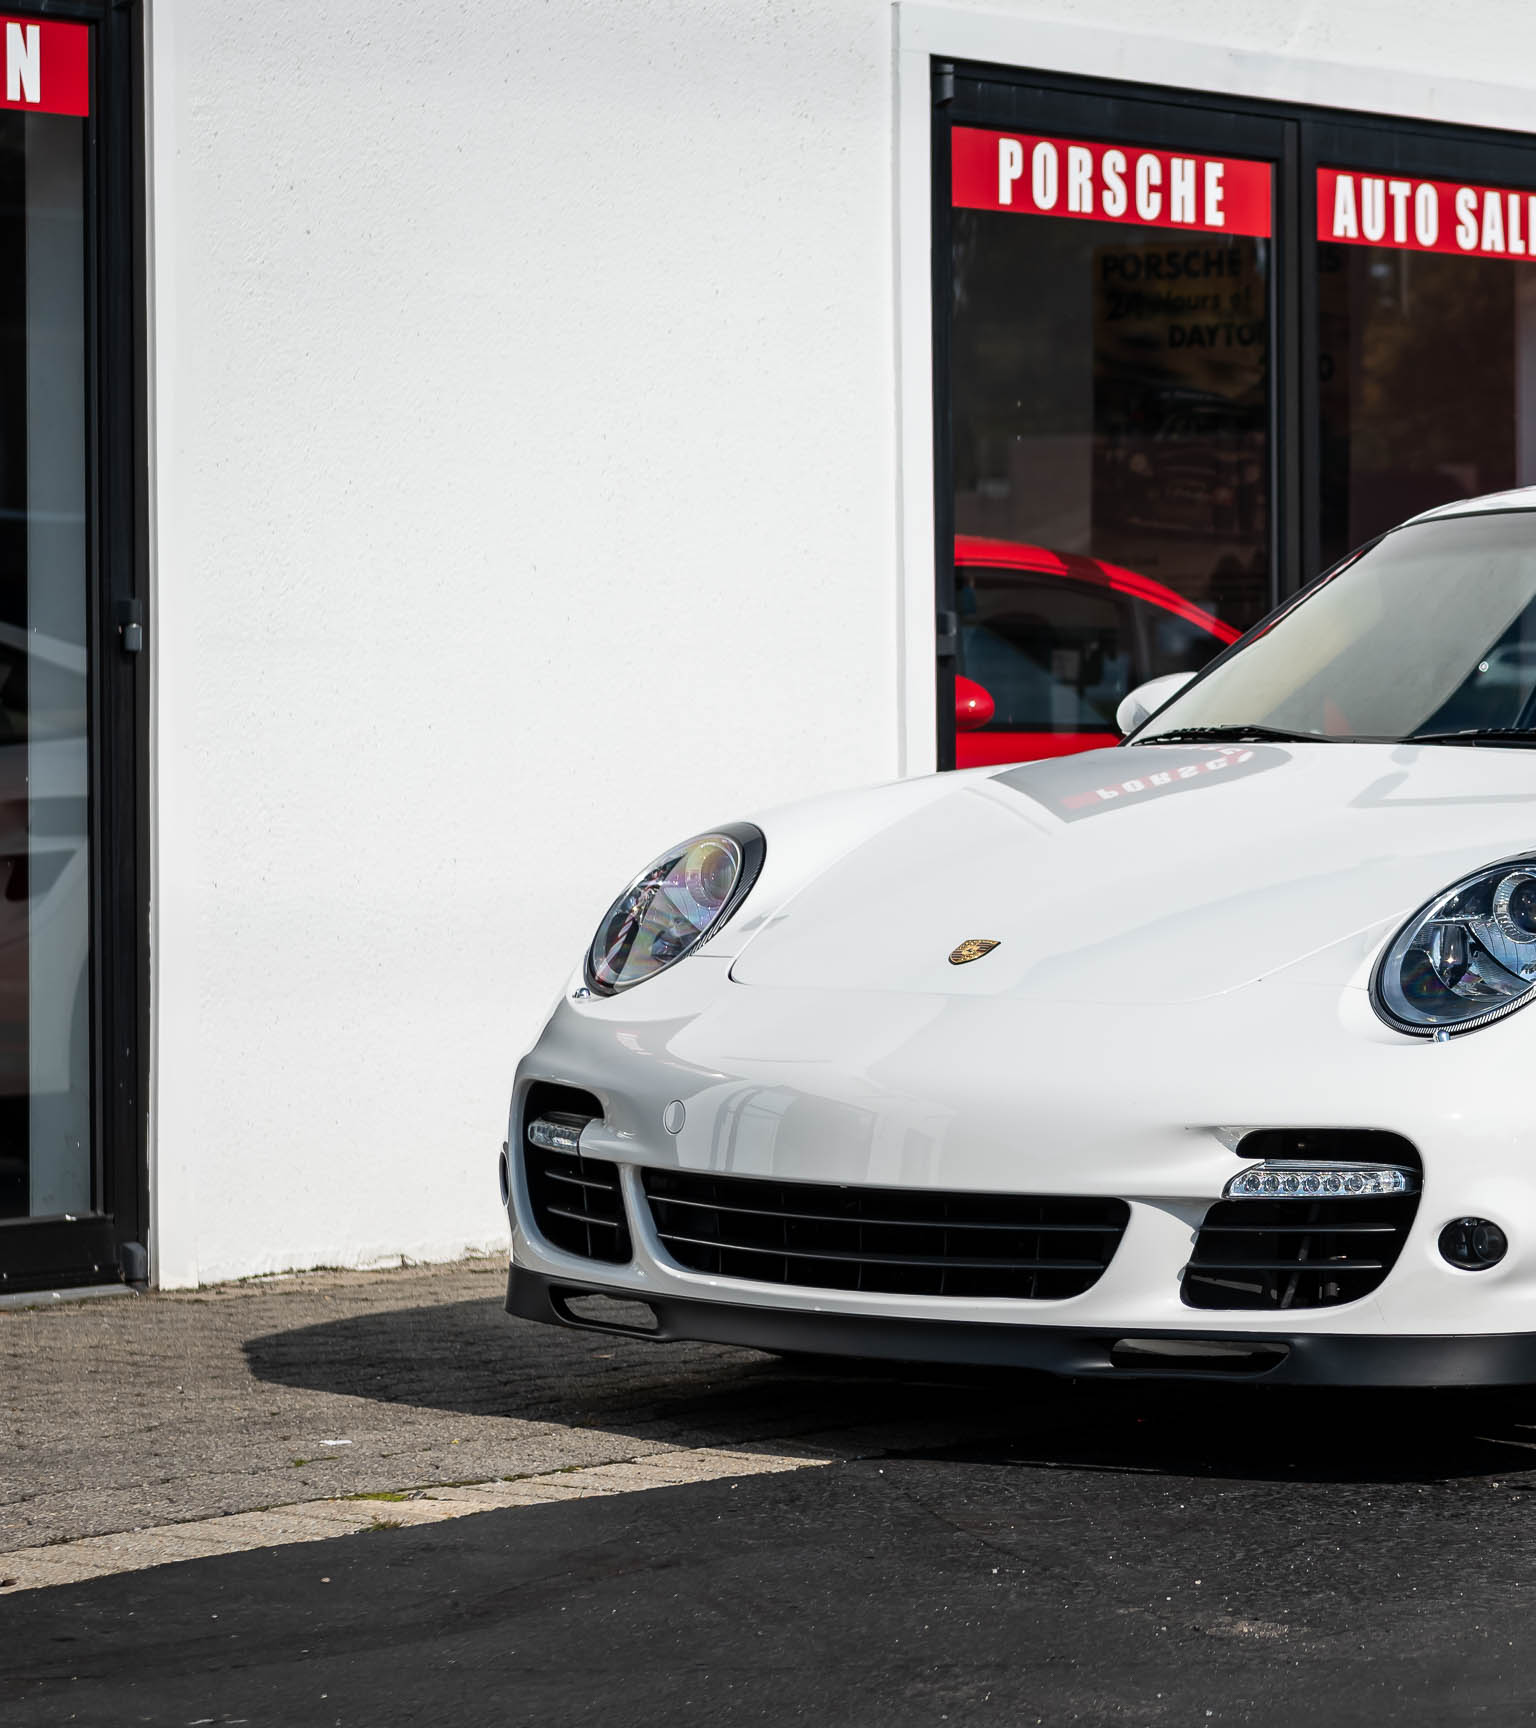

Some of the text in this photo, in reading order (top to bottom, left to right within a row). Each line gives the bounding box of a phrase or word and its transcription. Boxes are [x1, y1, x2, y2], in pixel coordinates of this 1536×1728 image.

[998, 137, 1226, 227] PORSCHE
[1332, 174, 1439, 248] AUTO
[1102, 248, 1242, 281] PORSCHE
[1168, 322, 1266, 348] DAYTO
